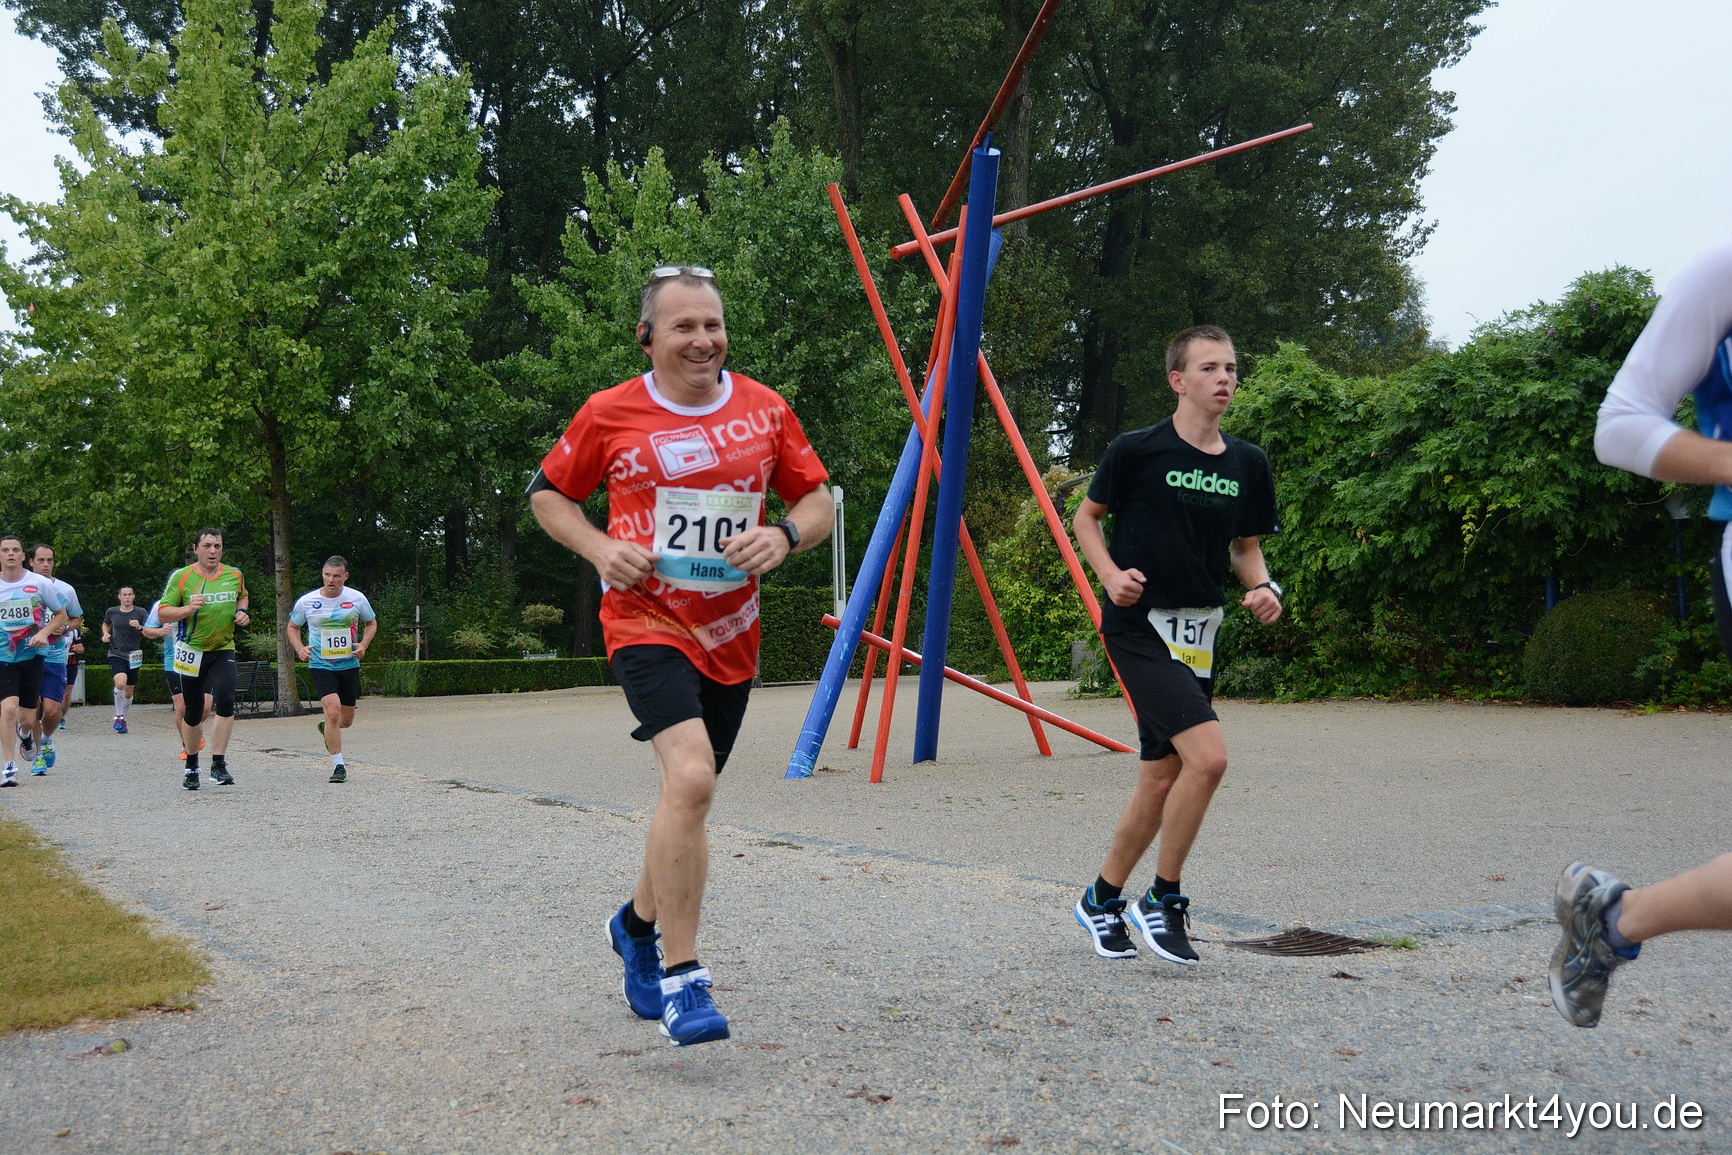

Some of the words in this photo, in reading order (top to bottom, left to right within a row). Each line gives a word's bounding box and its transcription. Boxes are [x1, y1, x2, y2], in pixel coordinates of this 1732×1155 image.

[1165, 468, 1239, 497] adidas
[706, 494, 754, 508] BOCK
[690, 562, 725, 578] Hans
[0, 606, 30, 620] 2488
[1166, 616, 1210, 646] 151
[327, 636, 347, 648] 169
[175, 647, 196, 664] 339
